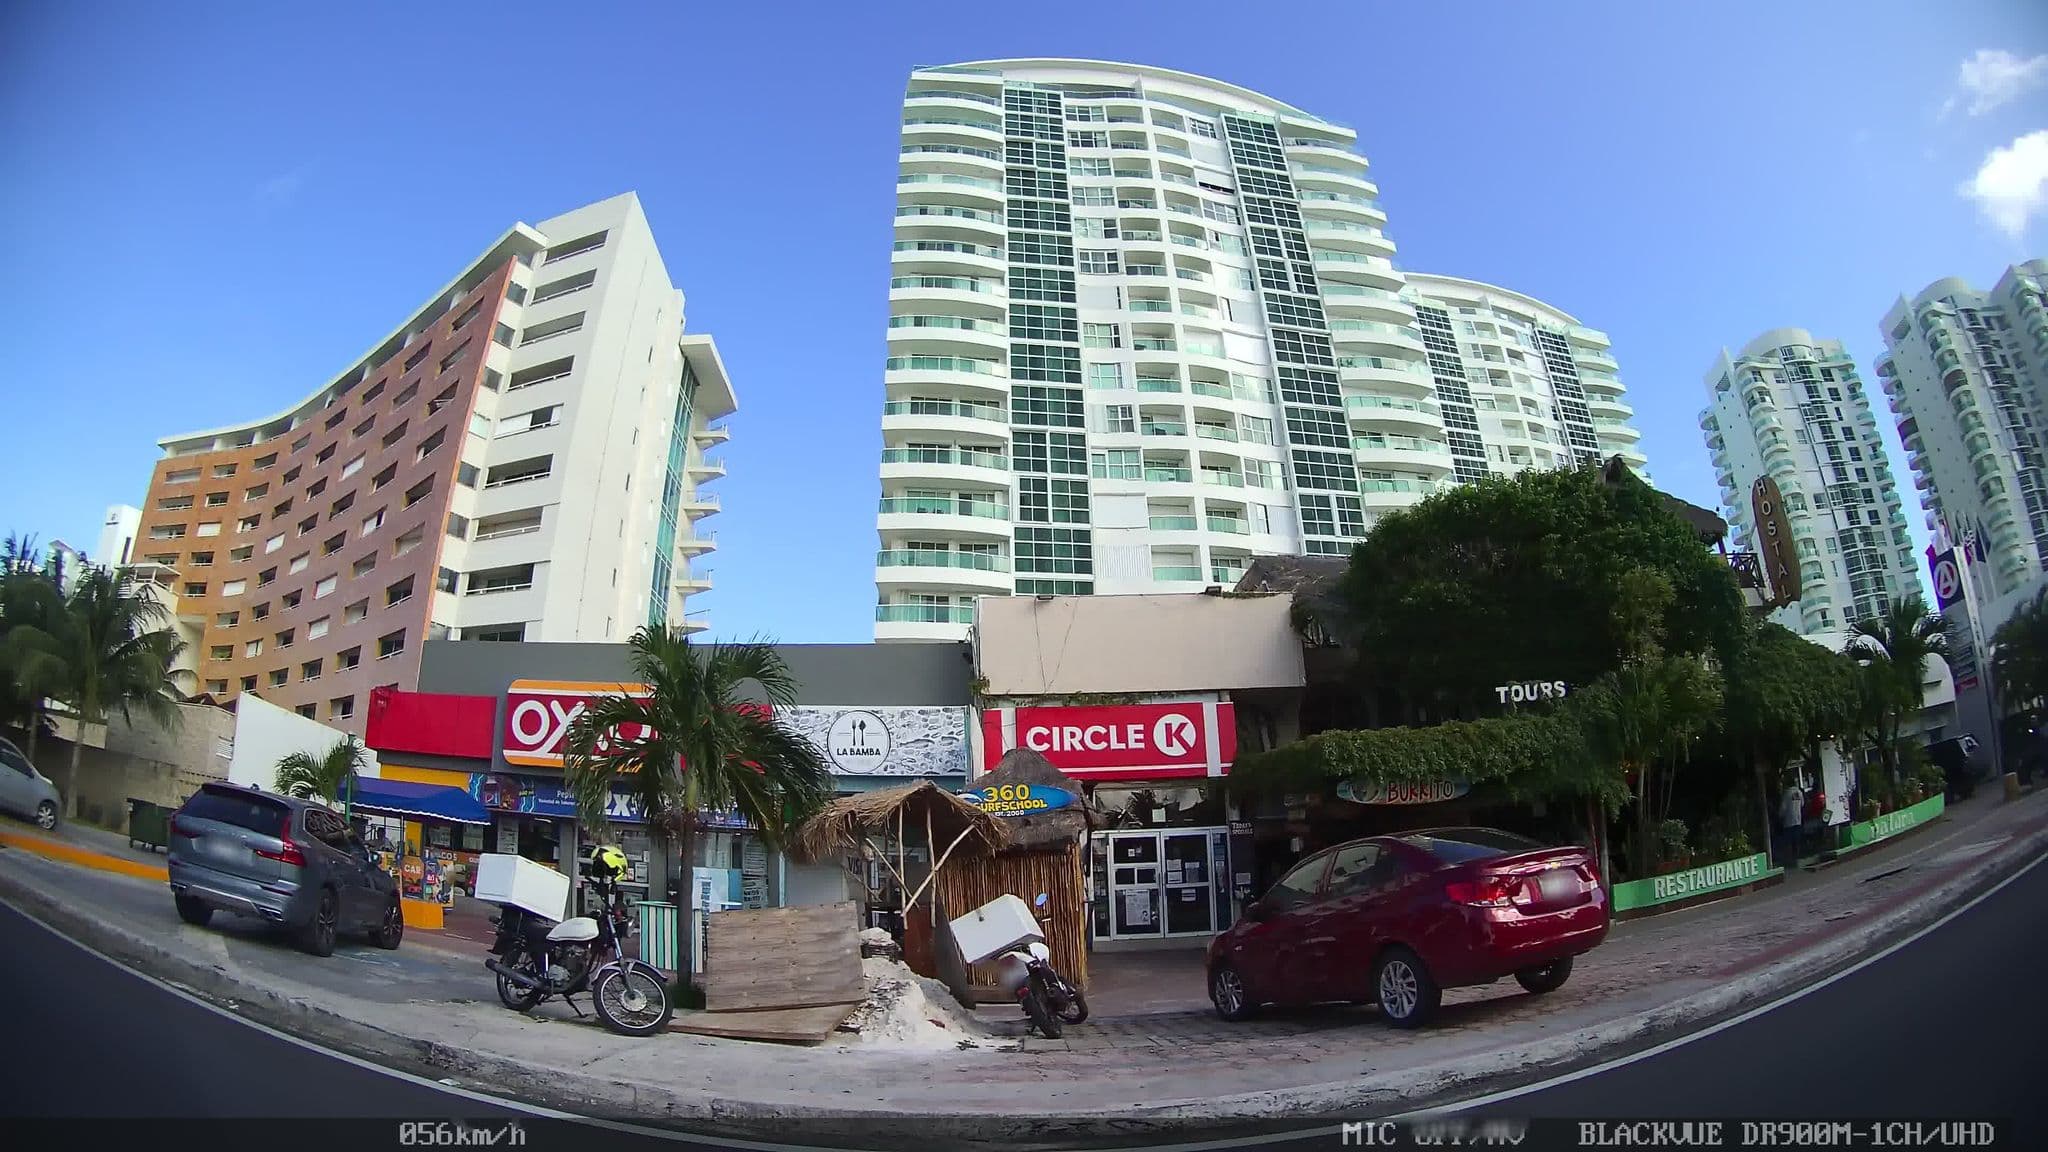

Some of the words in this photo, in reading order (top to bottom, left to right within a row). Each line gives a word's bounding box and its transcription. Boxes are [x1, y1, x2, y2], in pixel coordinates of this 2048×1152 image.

[1756, 479, 1791, 599] HOSTAL
[1495, 681, 1566, 703] TOURS
[511, 699, 653, 753] OXO
[1026, 724, 1145, 752] CIRCLE
[1164, 722, 1193, 754] K
[836, 748, 849, 756] LA
[850, 748, 881, 756] BAMBA
[982, 783, 1030, 802] 360
[1387, 781, 1454, 802] BURRITO
[1654, 856, 1759, 899] RESTAURANTE
